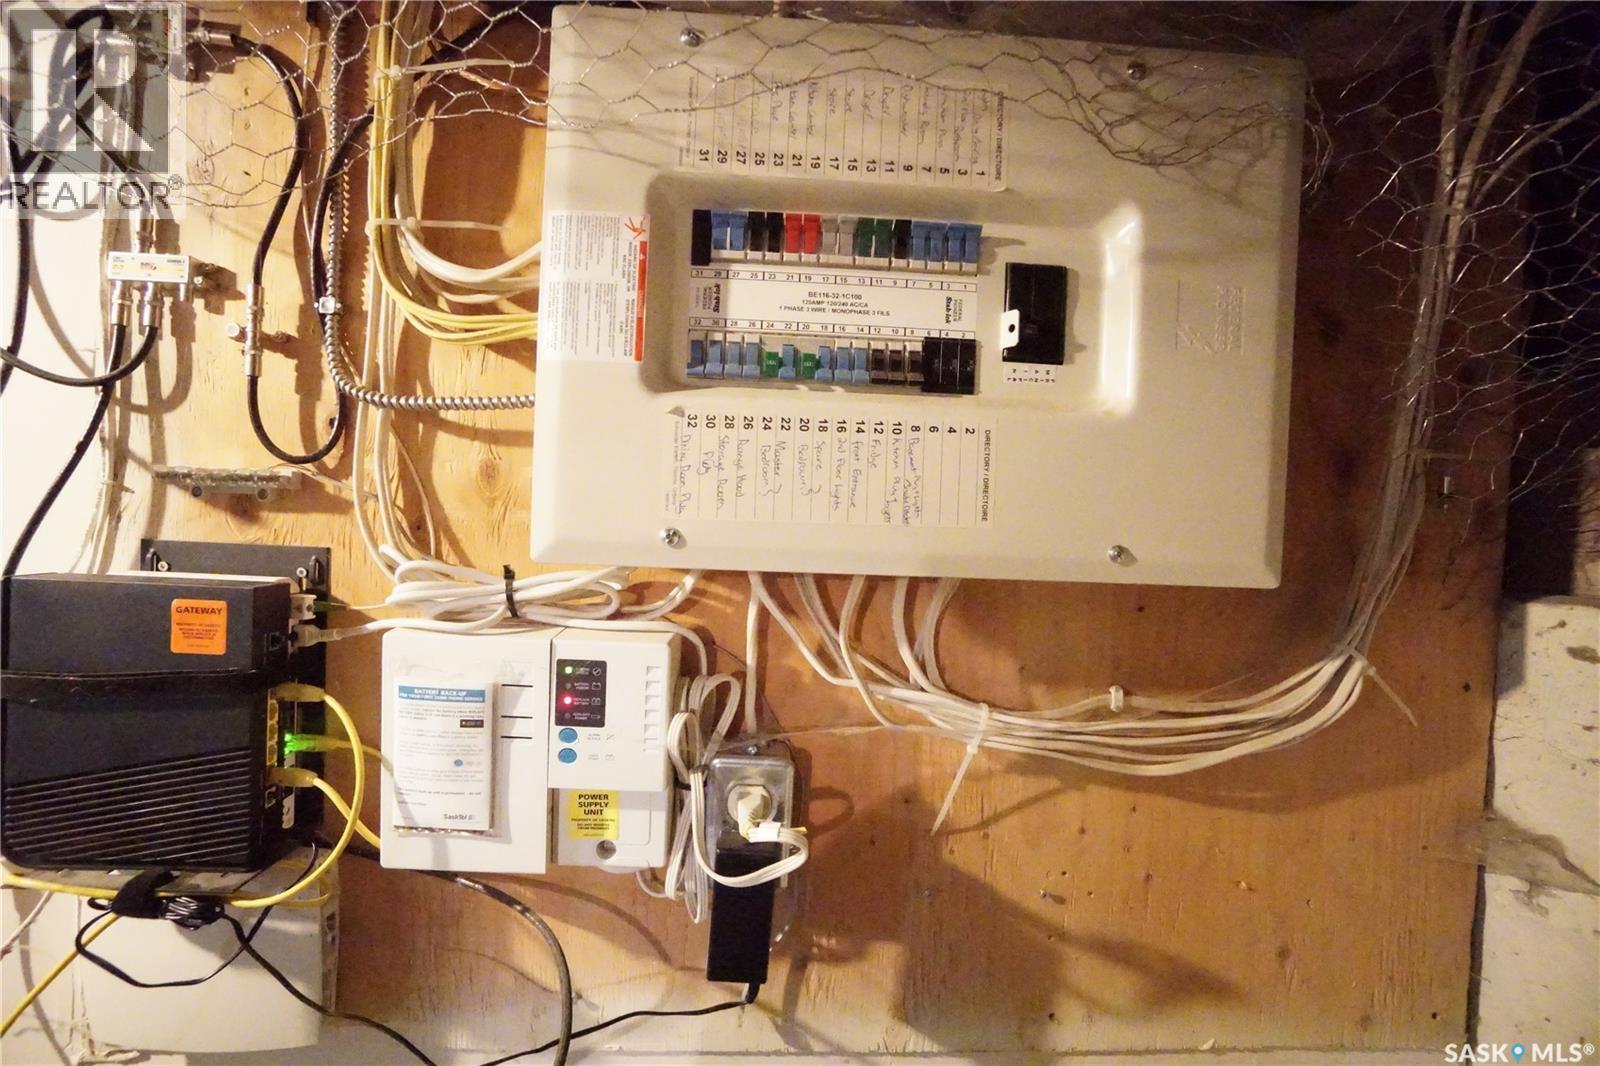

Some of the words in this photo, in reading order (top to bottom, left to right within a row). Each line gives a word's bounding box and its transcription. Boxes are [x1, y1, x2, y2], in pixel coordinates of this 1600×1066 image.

[699, 149, 709, 161] 31
[718, 150, 727, 163] 29
[736, 151, 746, 164] 27
[755, 152, 765, 165] 25
[773, 153, 783, 166] 23
[793, 154, 802, 167] 21
[811, 155, 820, 168] 19
[830, 156, 839, 170] 17
[848, 158, 857, 171] 15
[867, 159, 876, 172] 13
[885, 160, 894, 172] 11
[808, 291, 862, 300] BE116-32-1C100
[687, 414, 697, 428] 32
[706, 414, 716, 428] 30
[725, 415, 735, 429] 28
[744, 416, 753, 430] 26
[762, 416, 772, 430] 24
[781, 417, 791, 431] 22
[799, 418, 810, 432] 20
[818, 419, 828, 432] 18
[837, 419, 846, 433] 16
[856, 420, 865, 433] 14
[874, 421, 883, 434] 12
[892, 421, 902, 435] 10
[837, 437, 847, 453] 2nd
[713, 435, 729, 472] Storage
[734, 439, 749, 470] Range
[774, 441, 786, 476] Master
[813, 440, 825, 472] Spare
[867, 439, 881, 469] Fridge
[760, 445, 771, 486] Bedroom
[835, 458, 845, 479] Floor
[736, 475, 746, 498] Hood
[176, 606, 222, 615] GATEWAY
